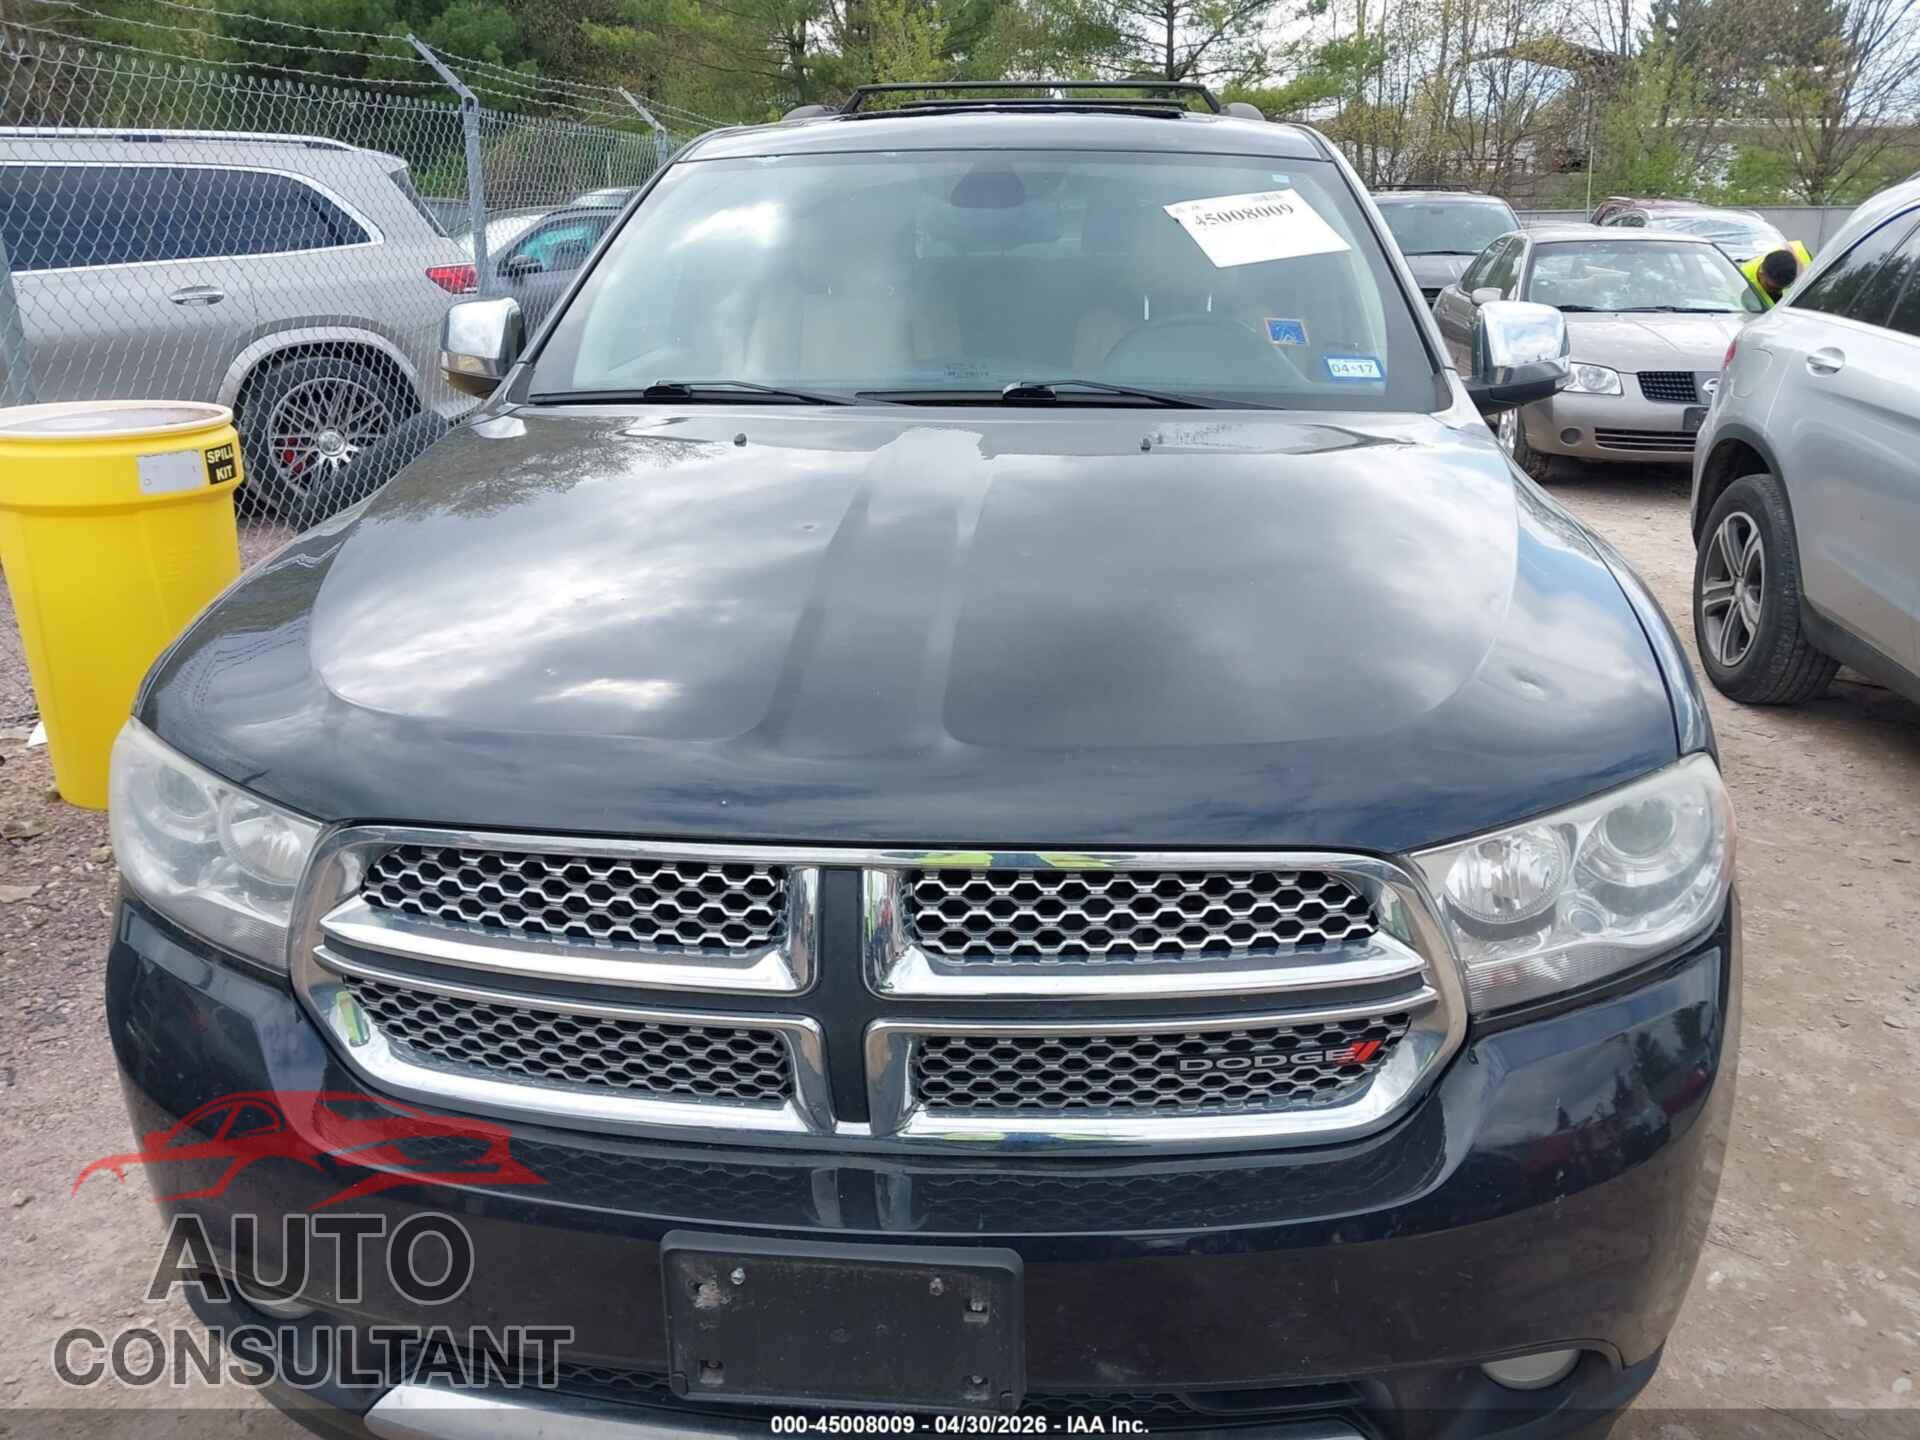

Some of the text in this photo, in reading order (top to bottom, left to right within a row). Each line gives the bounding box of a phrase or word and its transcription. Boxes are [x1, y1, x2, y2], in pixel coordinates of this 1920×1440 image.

[207, 445, 234, 464] SPILL
[216, 465, 233, 481] KIT
[1179, 1047, 1355, 1072] DODGE
